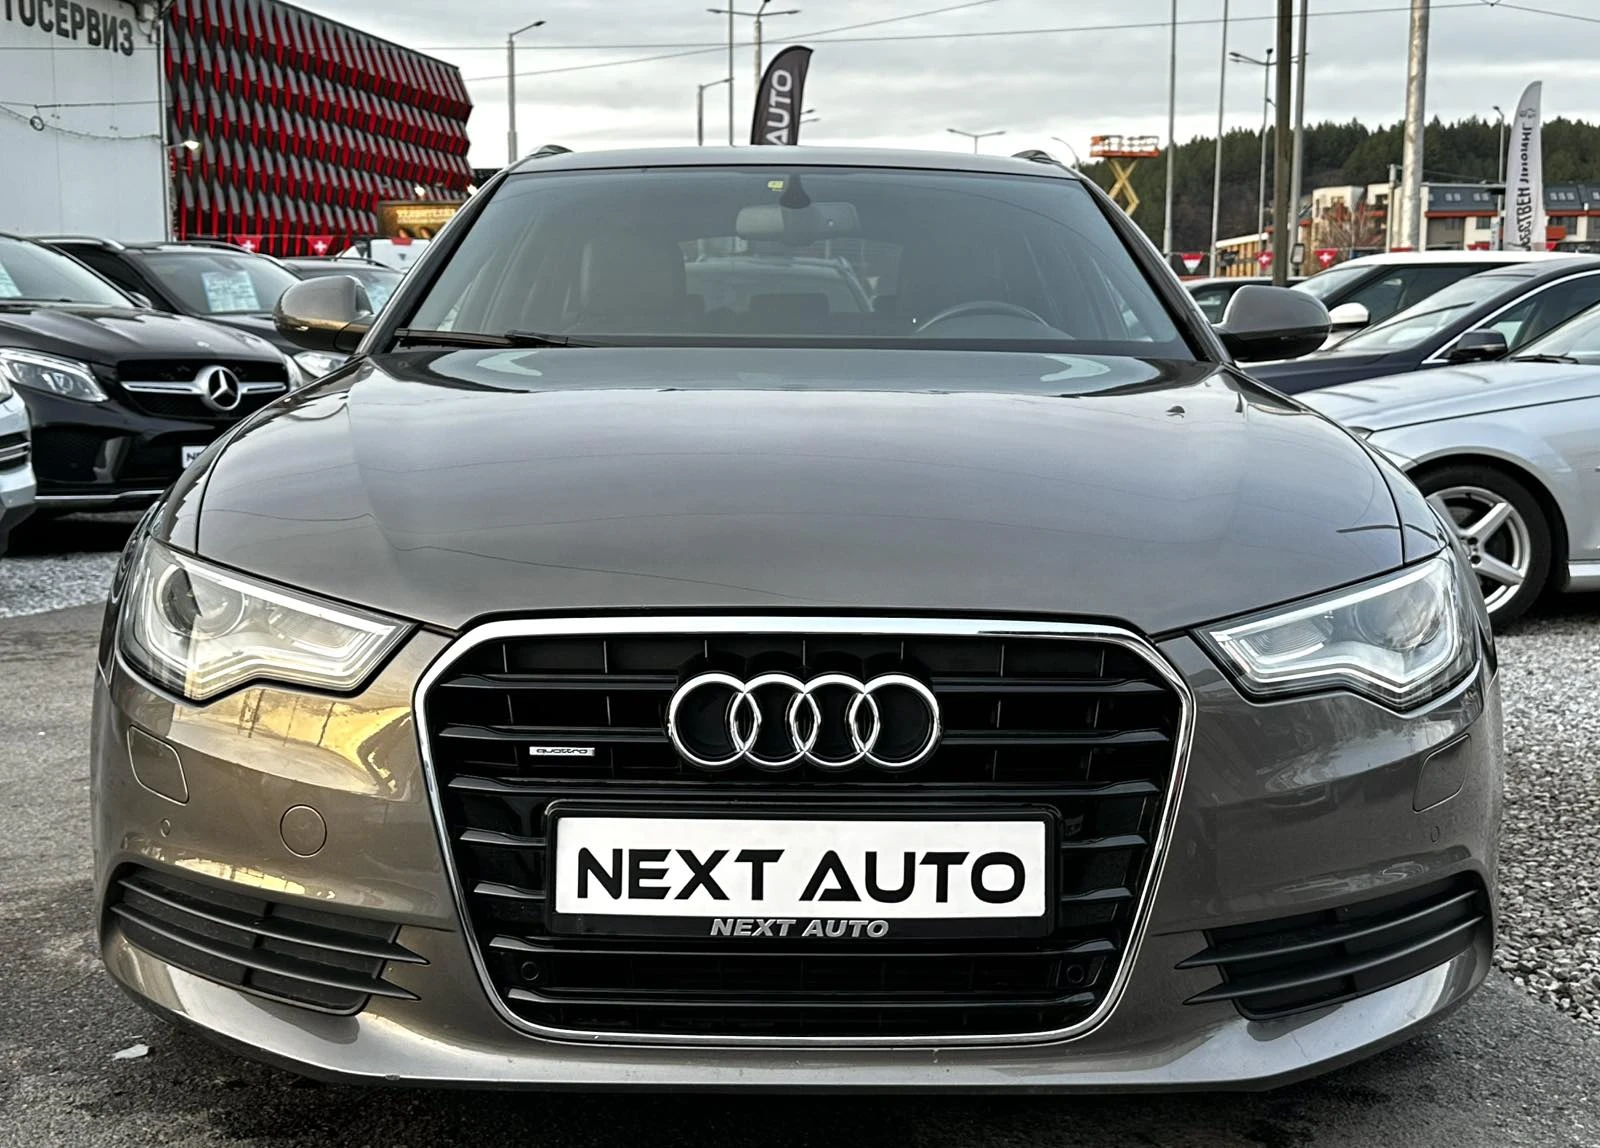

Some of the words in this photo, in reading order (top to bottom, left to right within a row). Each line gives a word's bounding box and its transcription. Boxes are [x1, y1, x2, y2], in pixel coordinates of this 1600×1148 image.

[766, 69, 793, 145] AUTO
[577, 847, 786, 900] NEXT
[798, 850, 1026, 904] AUTO
[710, 918, 797, 937] NEXT
[801, 919, 889, 938] AUTO
